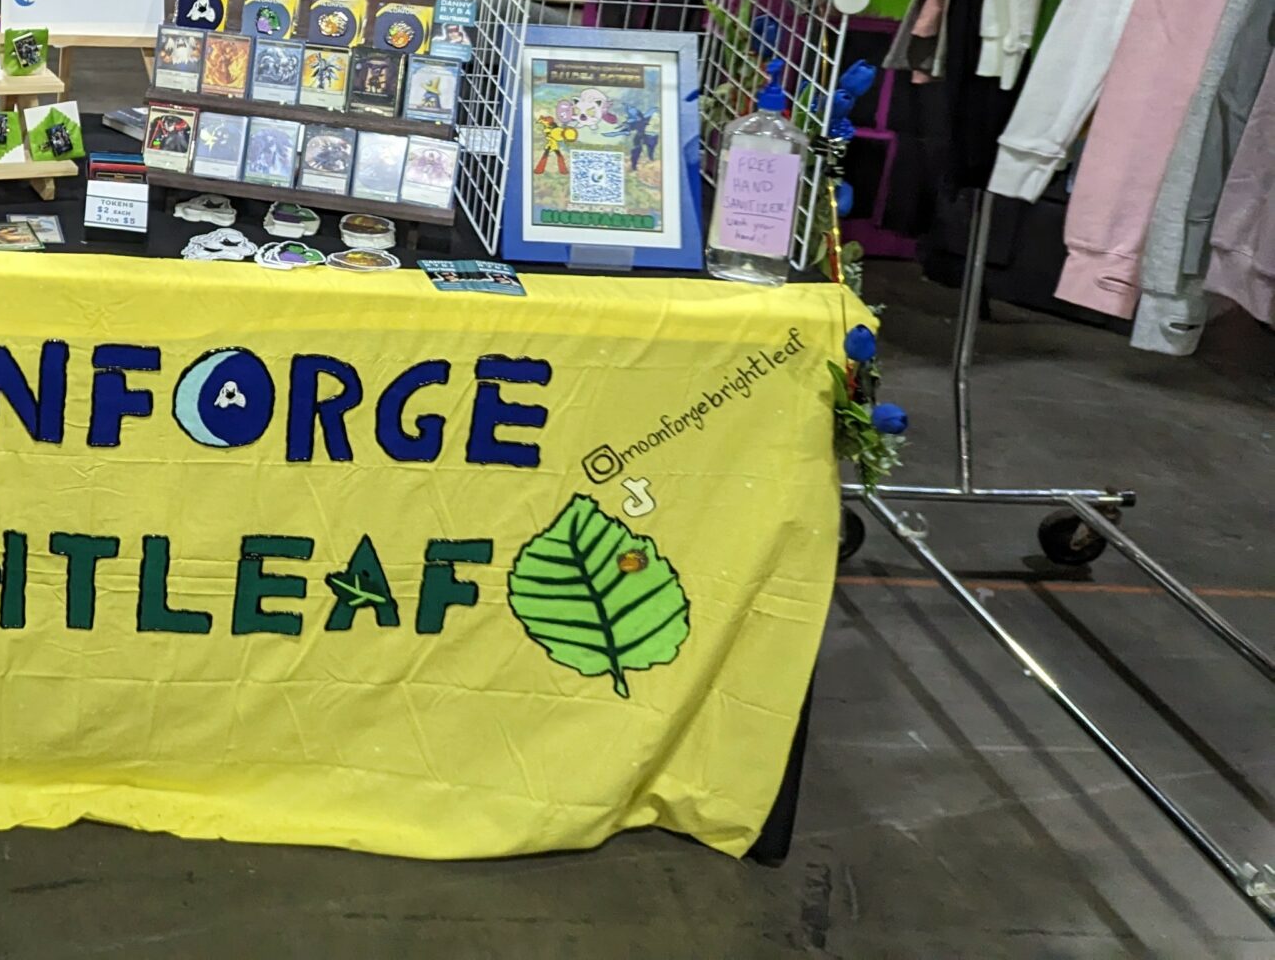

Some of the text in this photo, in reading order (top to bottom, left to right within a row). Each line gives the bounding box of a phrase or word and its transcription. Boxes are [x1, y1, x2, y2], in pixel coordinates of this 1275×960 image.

[440, 0, 471, 8] DANNY
[738, 156, 777, 174] FREE
[733, 177, 773, 193] HAND
[101, 200, 134, 208] TOKENS
[97, 206, 109, 214] $2
[123, 216, 136, 224] $5
